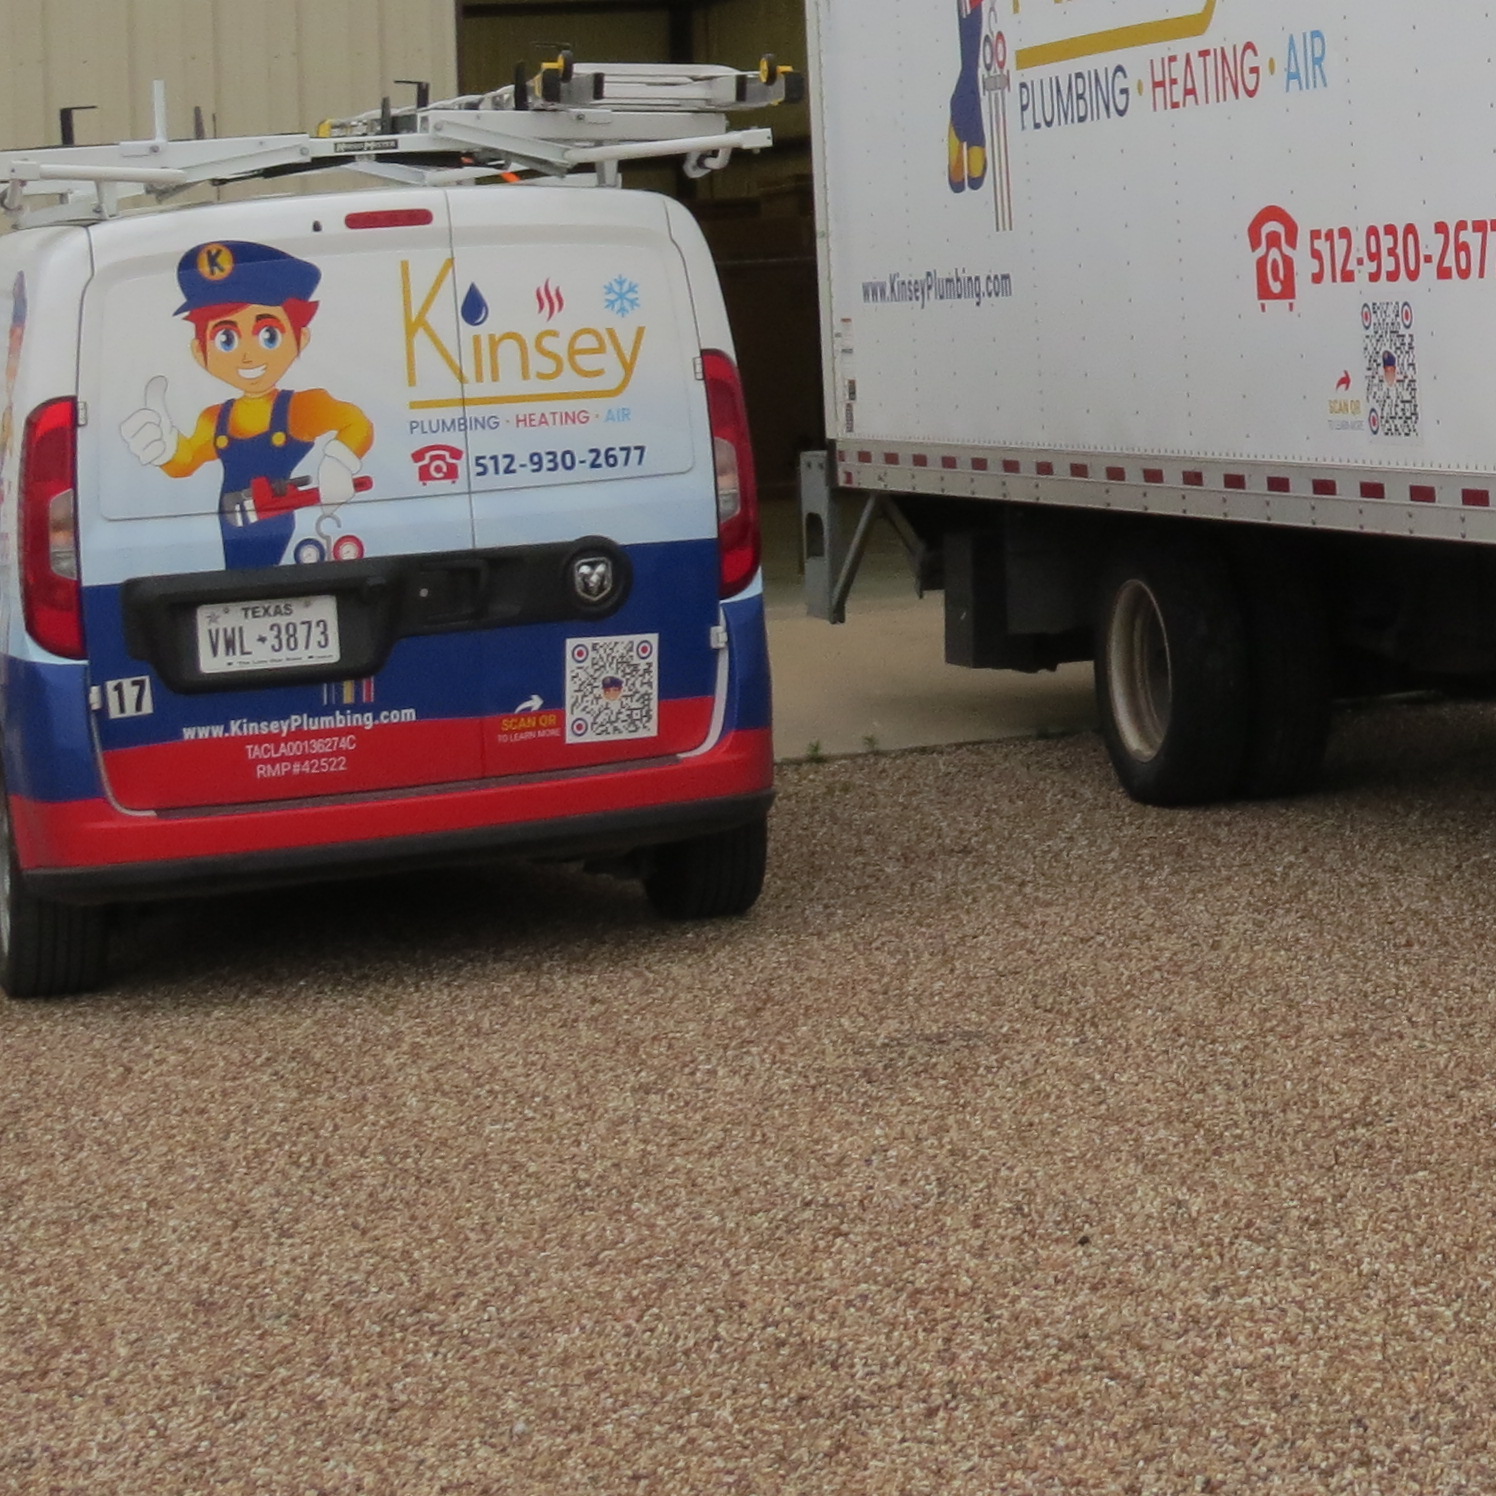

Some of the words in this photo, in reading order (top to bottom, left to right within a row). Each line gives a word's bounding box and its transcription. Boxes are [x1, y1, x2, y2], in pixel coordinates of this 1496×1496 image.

[1018, 64, 1130, 131] PLUMBING
[1150, 41, 1261, 112] HEATING
[1285, 29, 1328, 93] AIR
[206, 248, 226, 277] K
[862, 267, 1012, 310] www.KinseyPlumbing.com
[400, 257, 647, 406] Kinsey
[408, 414, 501, 435] PLUMBING
[515, 409, 590, 428] HEATING
[603, 407, 632, 423] AIR
[475, 445, 647, 476] 512-930-2677
[242, 603, 294, 619] TEXAS
[208, 625, 253, 658] VWL
[269, 619, 330, 653] 3873
[113, 678, 146, 715] 17
[182, 707, 417, 740] www.KinseyPlumbing.com
[501, 716, 536, 731] SCAN
[539, 714, 558, 727] QR
[245, 734, 357, 760] TACLA00136274C
[256, 757, 347, 779] RMP#42522
